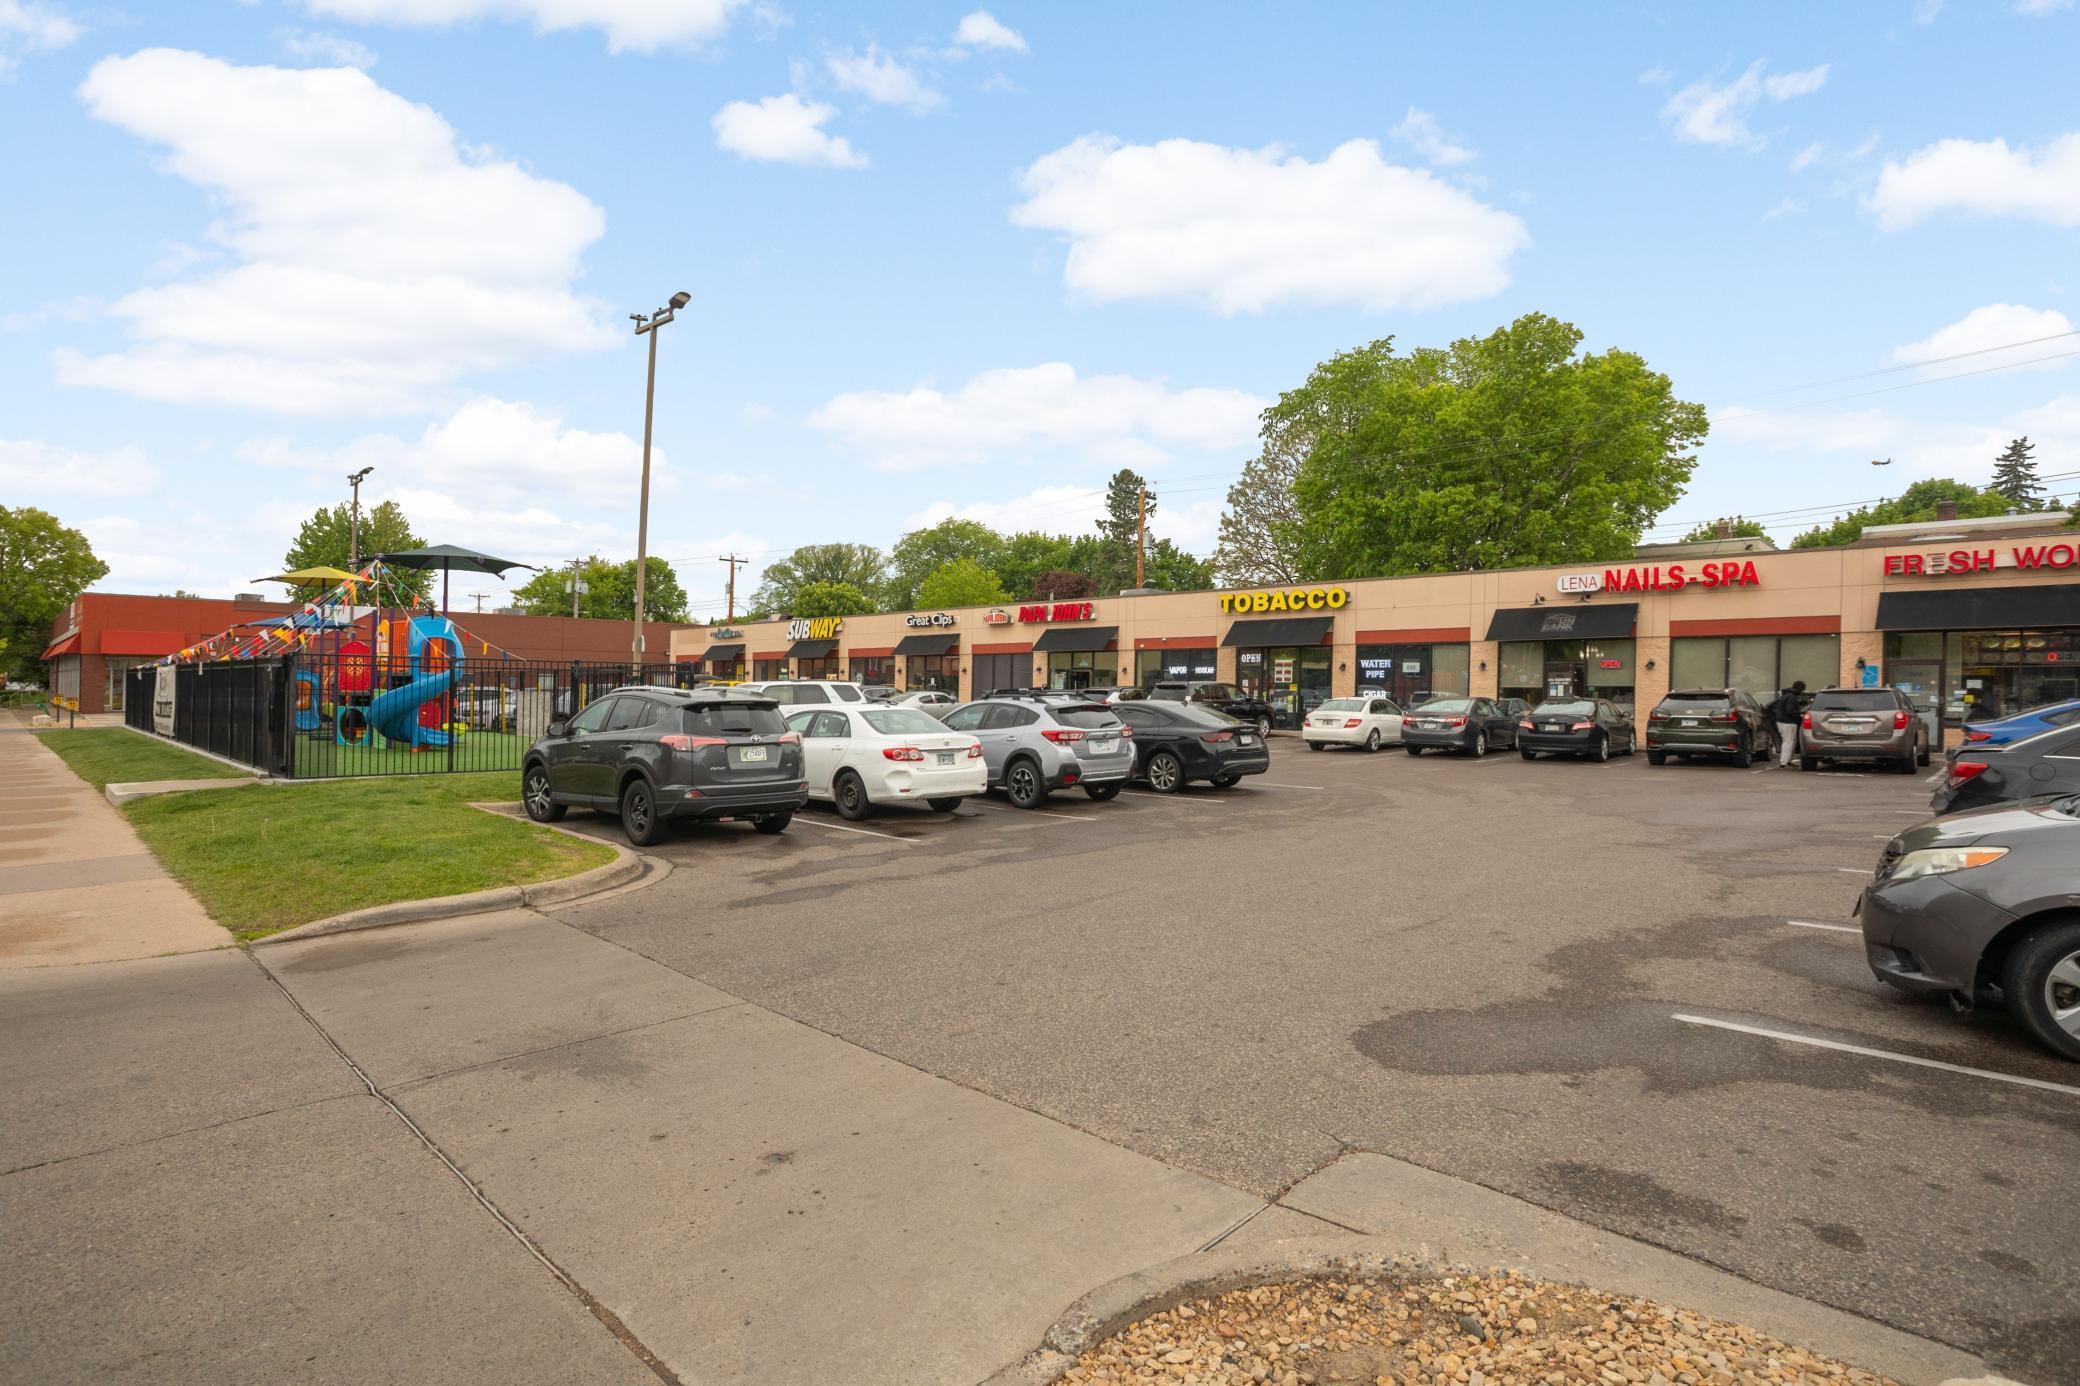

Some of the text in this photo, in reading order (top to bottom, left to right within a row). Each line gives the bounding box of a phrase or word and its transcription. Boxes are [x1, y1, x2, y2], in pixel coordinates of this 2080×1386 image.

[1884, 543, 2080, 577] FRESH WO
[1561, 576, 1598, 590] LENA
[1219, 587, 1346, 613] TOBACCO
[1018, 605, 1048, 624] PAPA
[1051, 602, 1093, 622] JOHN'S
[905, 613, 953, 628] Great Clips
[785, 616, 842, 640] SUBWAY
[1241, 653, 1262, 663] OPEN
[1360, 659, 1392, 669] WATER
[1168, 666, 1188, 674] VAPOR
[1365, 670, 1385, 679] PIPE
[1363, 690, 1387, 699] CIGAR
